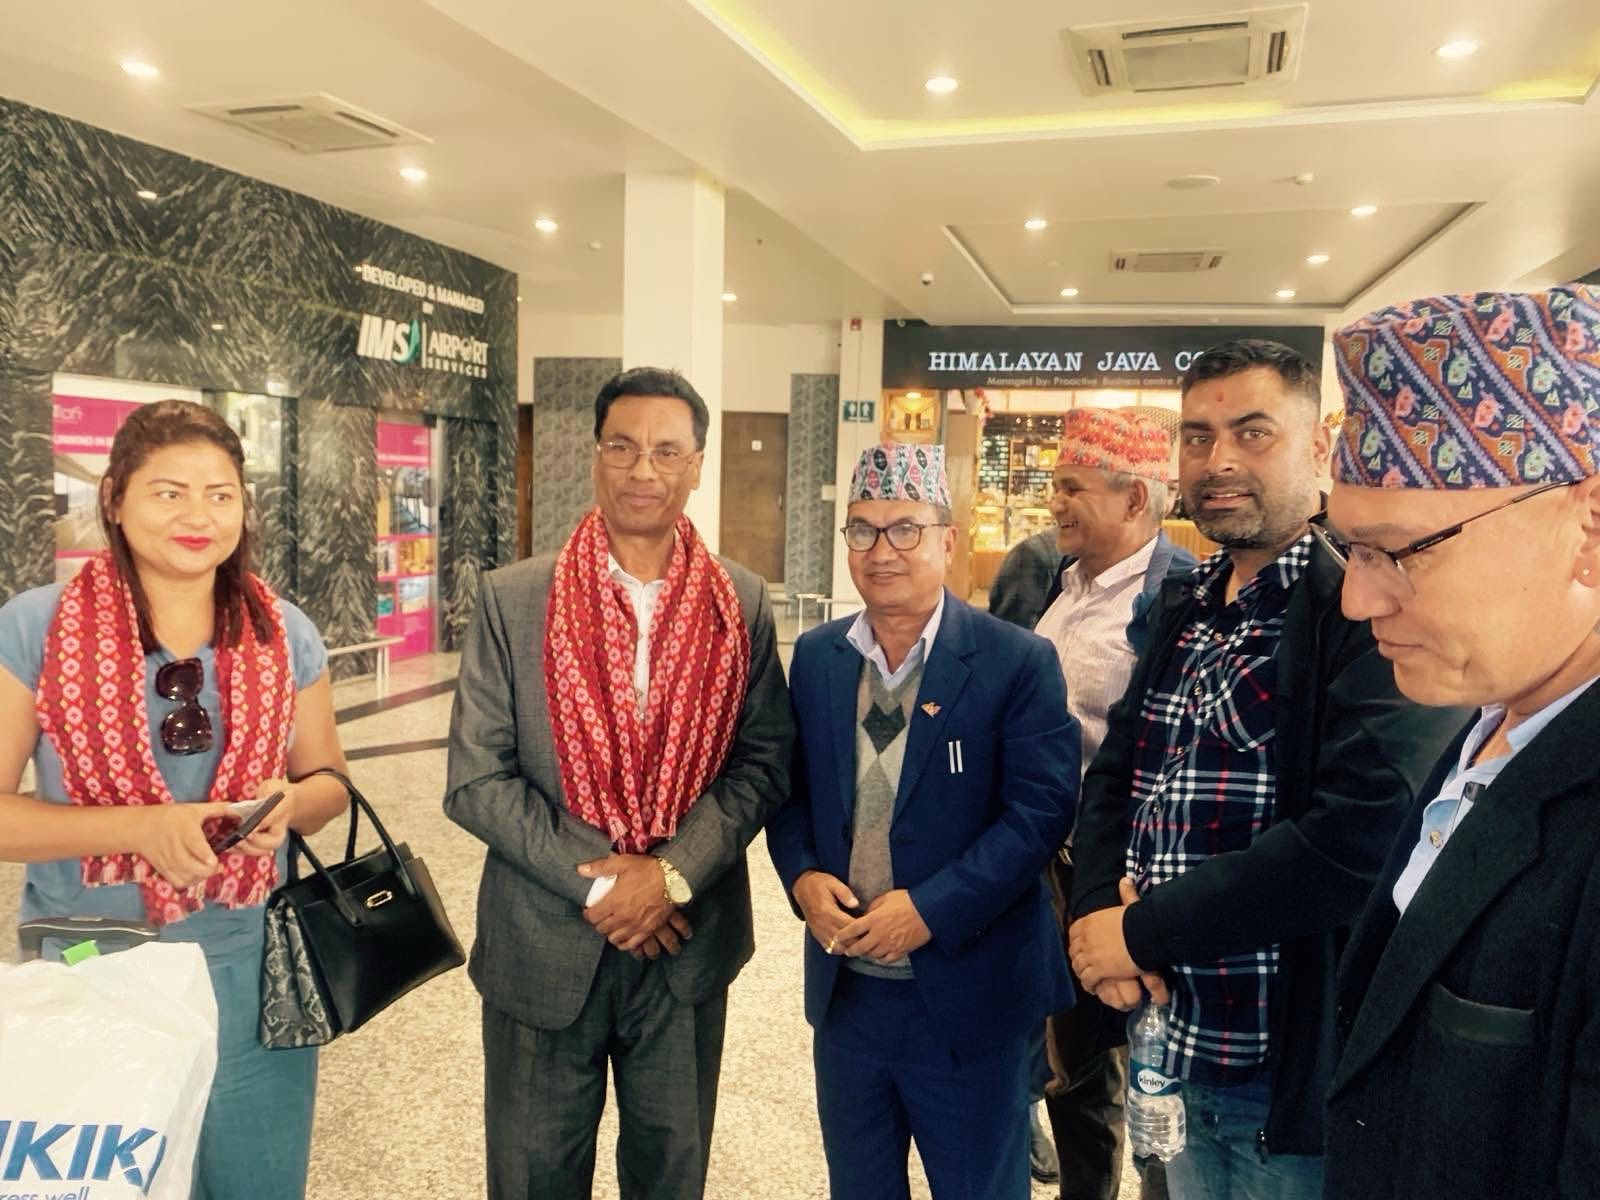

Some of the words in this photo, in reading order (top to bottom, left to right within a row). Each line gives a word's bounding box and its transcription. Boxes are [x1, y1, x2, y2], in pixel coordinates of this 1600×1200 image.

[362, 264, 426, 297] DEVELOPED
[427, 284, 436, 299] &
[437, 286, 485, 315] MANAGED
[357, 314, 413, 364] IMS
[428, 331, 488, 366] AIRPORT
[427, 357, 487, 379] SERVICES
[928, 351, 1083, 372] HIMALAYAN
[1097, 351, 1161, 372] JAVA
[986, 376, 1033, 387] Managed
[1053, 376, 1098, 386] Proactive
[1102, 376, 1140, 386] Business
[1143, 377, 1174, 386] centre
